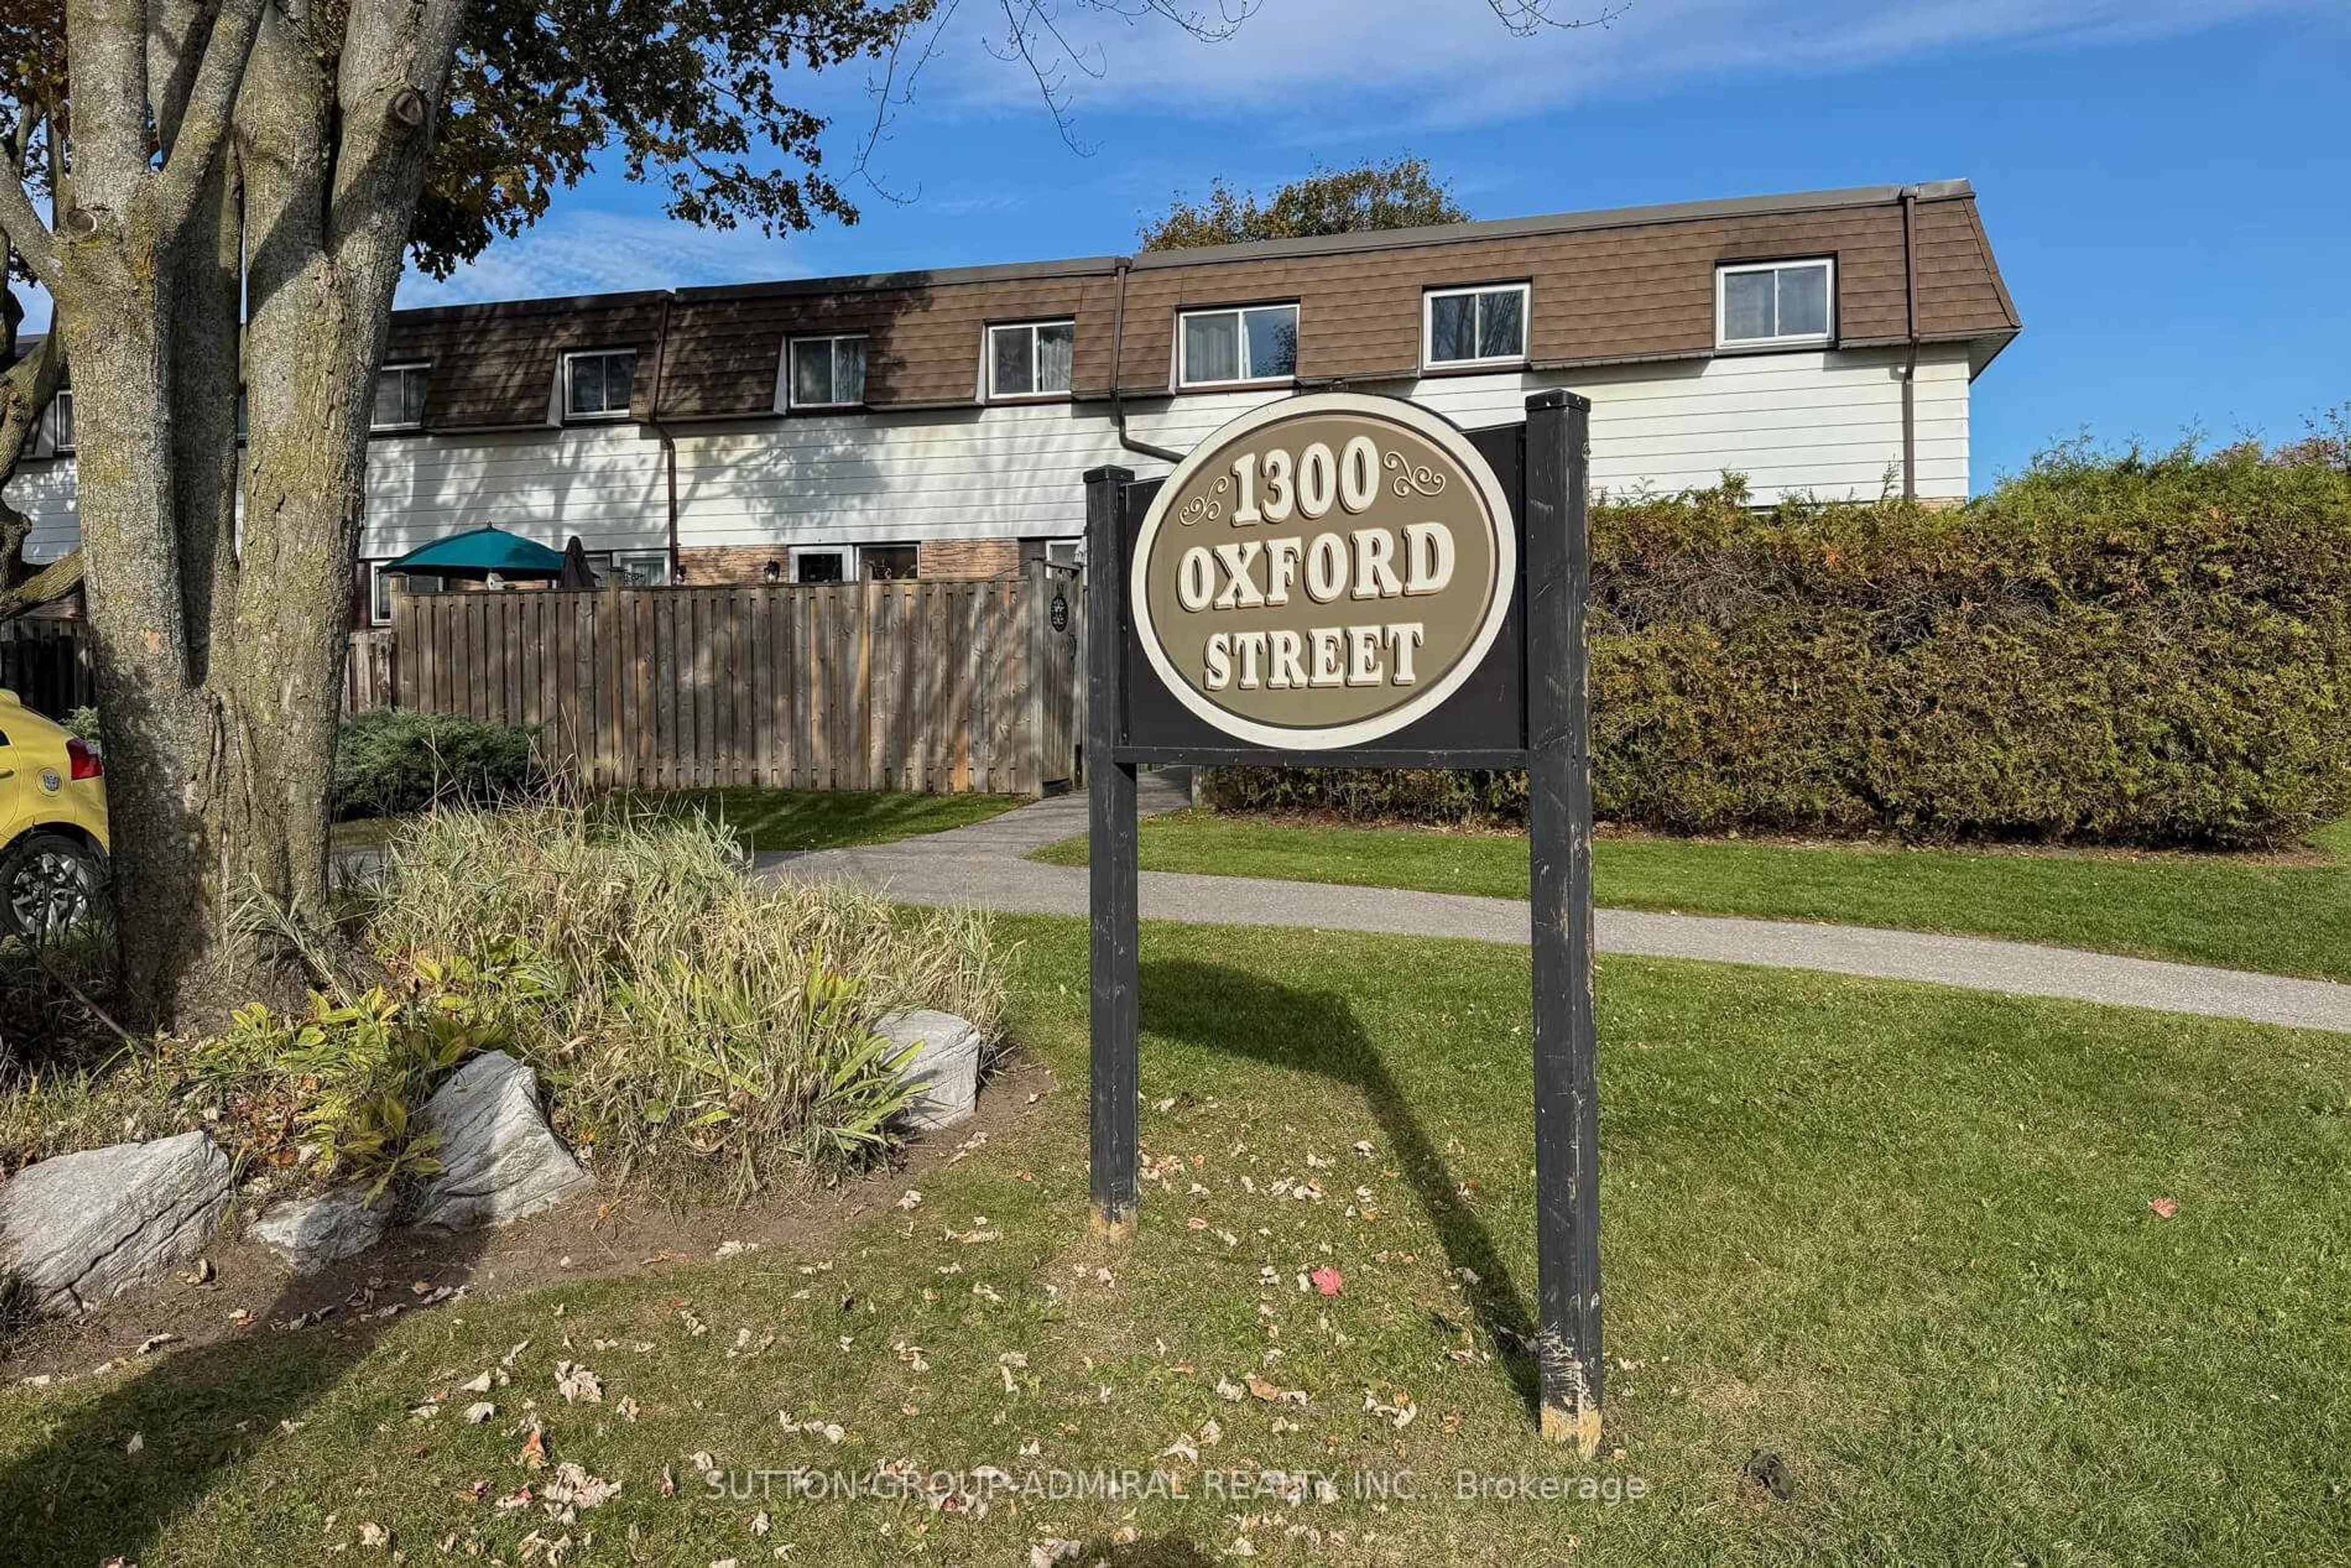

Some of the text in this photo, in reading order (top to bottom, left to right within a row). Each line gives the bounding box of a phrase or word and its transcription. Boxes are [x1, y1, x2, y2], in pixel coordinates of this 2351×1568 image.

[1231, 435, 1381, 527] 1300
[1177, 522, 1455, 612] OXFORD
[1204, 622, 1424, 690] STREET
